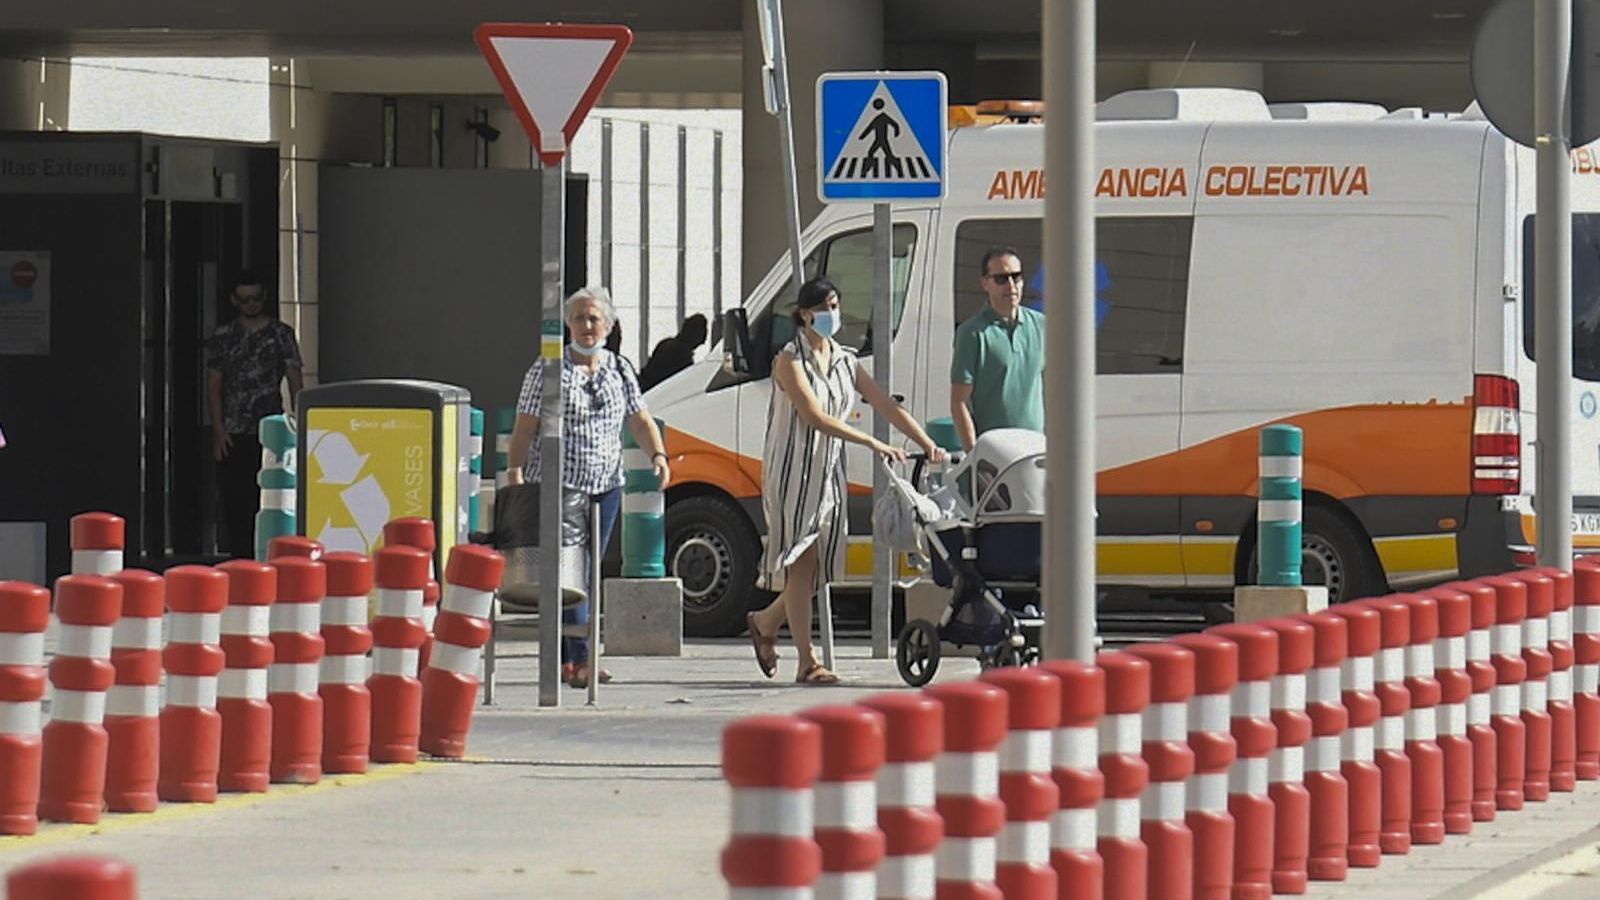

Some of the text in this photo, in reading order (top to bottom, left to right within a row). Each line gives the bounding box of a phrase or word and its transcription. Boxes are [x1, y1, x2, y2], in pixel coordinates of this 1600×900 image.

[42, 158, 128, 177] Externas
[987, 165, 1369, 200] AMANCIA COLECTIVA
